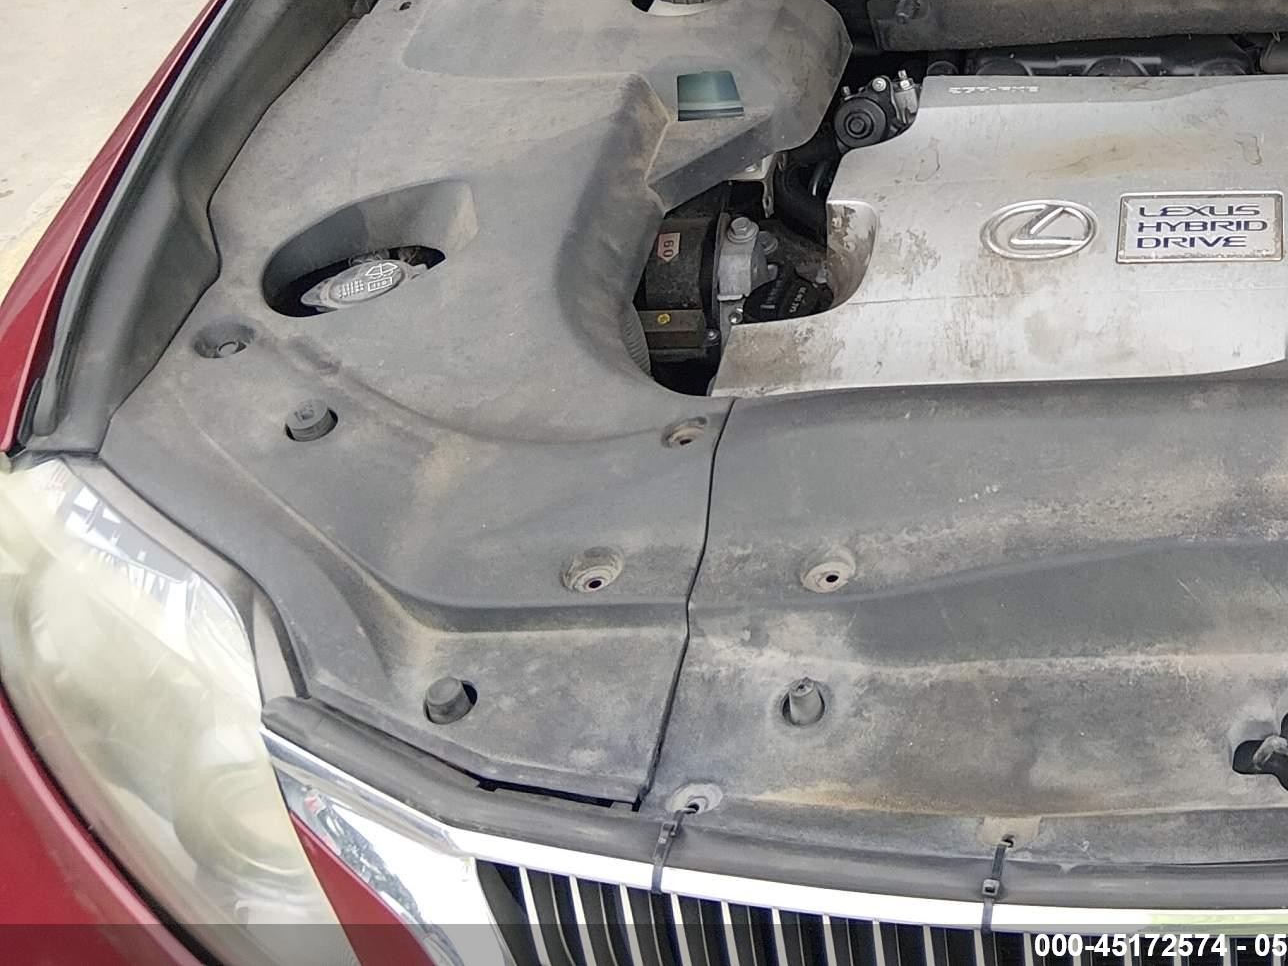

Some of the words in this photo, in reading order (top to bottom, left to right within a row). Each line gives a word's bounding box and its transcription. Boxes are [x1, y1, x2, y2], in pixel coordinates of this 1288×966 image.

[1138, 204, 1261, 217] LEXUS
[1137, 220, 1268, 233] HYBRID
[1136, 236, 1248, 249] DRIVE
